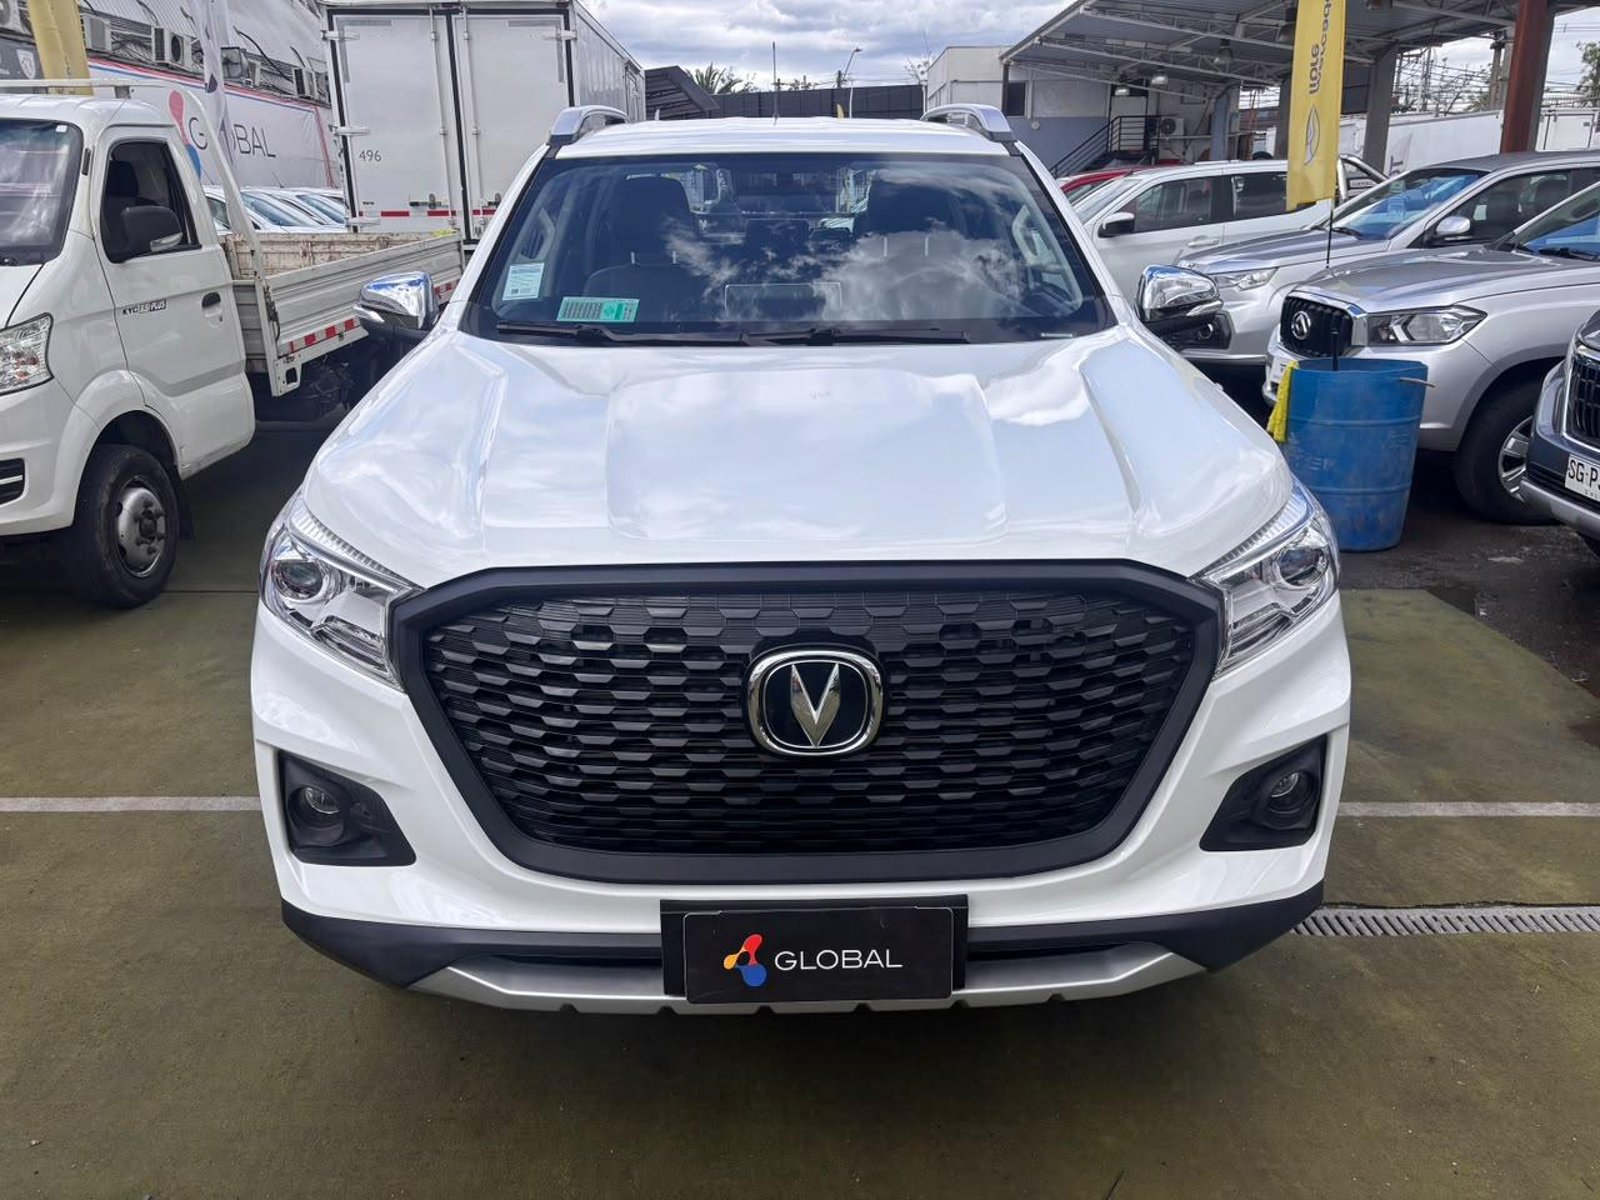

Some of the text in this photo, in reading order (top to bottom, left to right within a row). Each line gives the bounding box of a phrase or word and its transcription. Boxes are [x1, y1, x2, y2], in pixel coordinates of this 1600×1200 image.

[189, 116, 277, 158] GBAL
[359, 150, 381, 162] 496
[774, 949, 903, 971] GLOBAL
